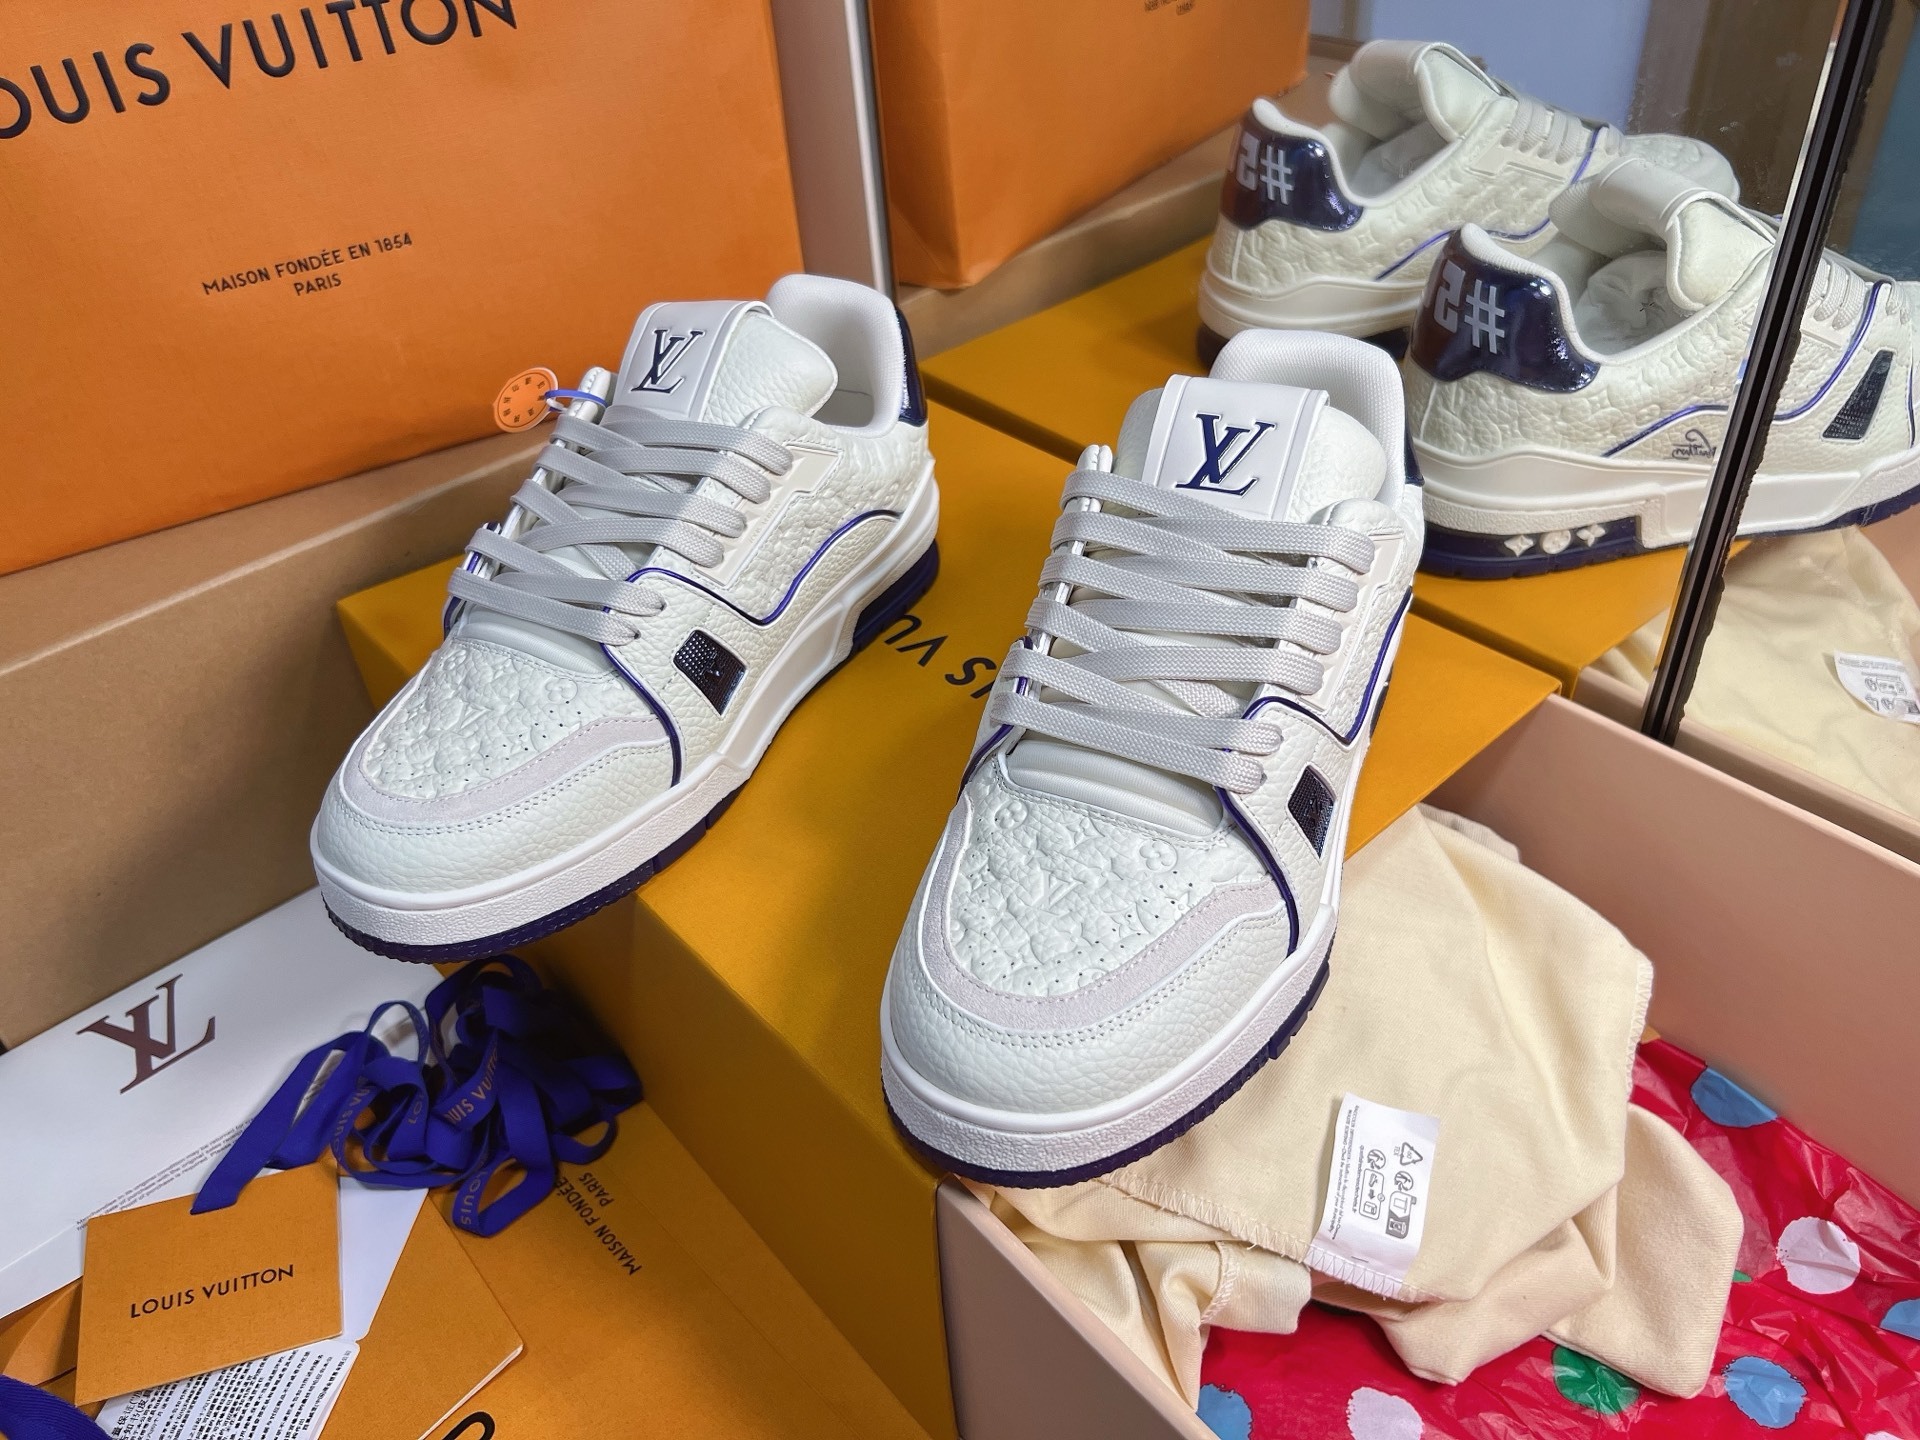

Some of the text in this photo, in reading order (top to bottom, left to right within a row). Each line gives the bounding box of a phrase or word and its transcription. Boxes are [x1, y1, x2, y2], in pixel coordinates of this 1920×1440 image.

[181, 0, 517, 89] VUITTON
[202, 232, 413, 295] MAISON FONDÉE EN 1854
[293, 273, 342, 296] PARIS
[631, 329, 703, 393] LV
[1175, 413, 1275, 496] LV
[76, 973, 215, 1095] LV
[579, 1172, 614, 1207] PARIS
[594, 1224, 642, 1275] MAISON
[131, 1264, 294, 1318] LOUIS VUITTON
